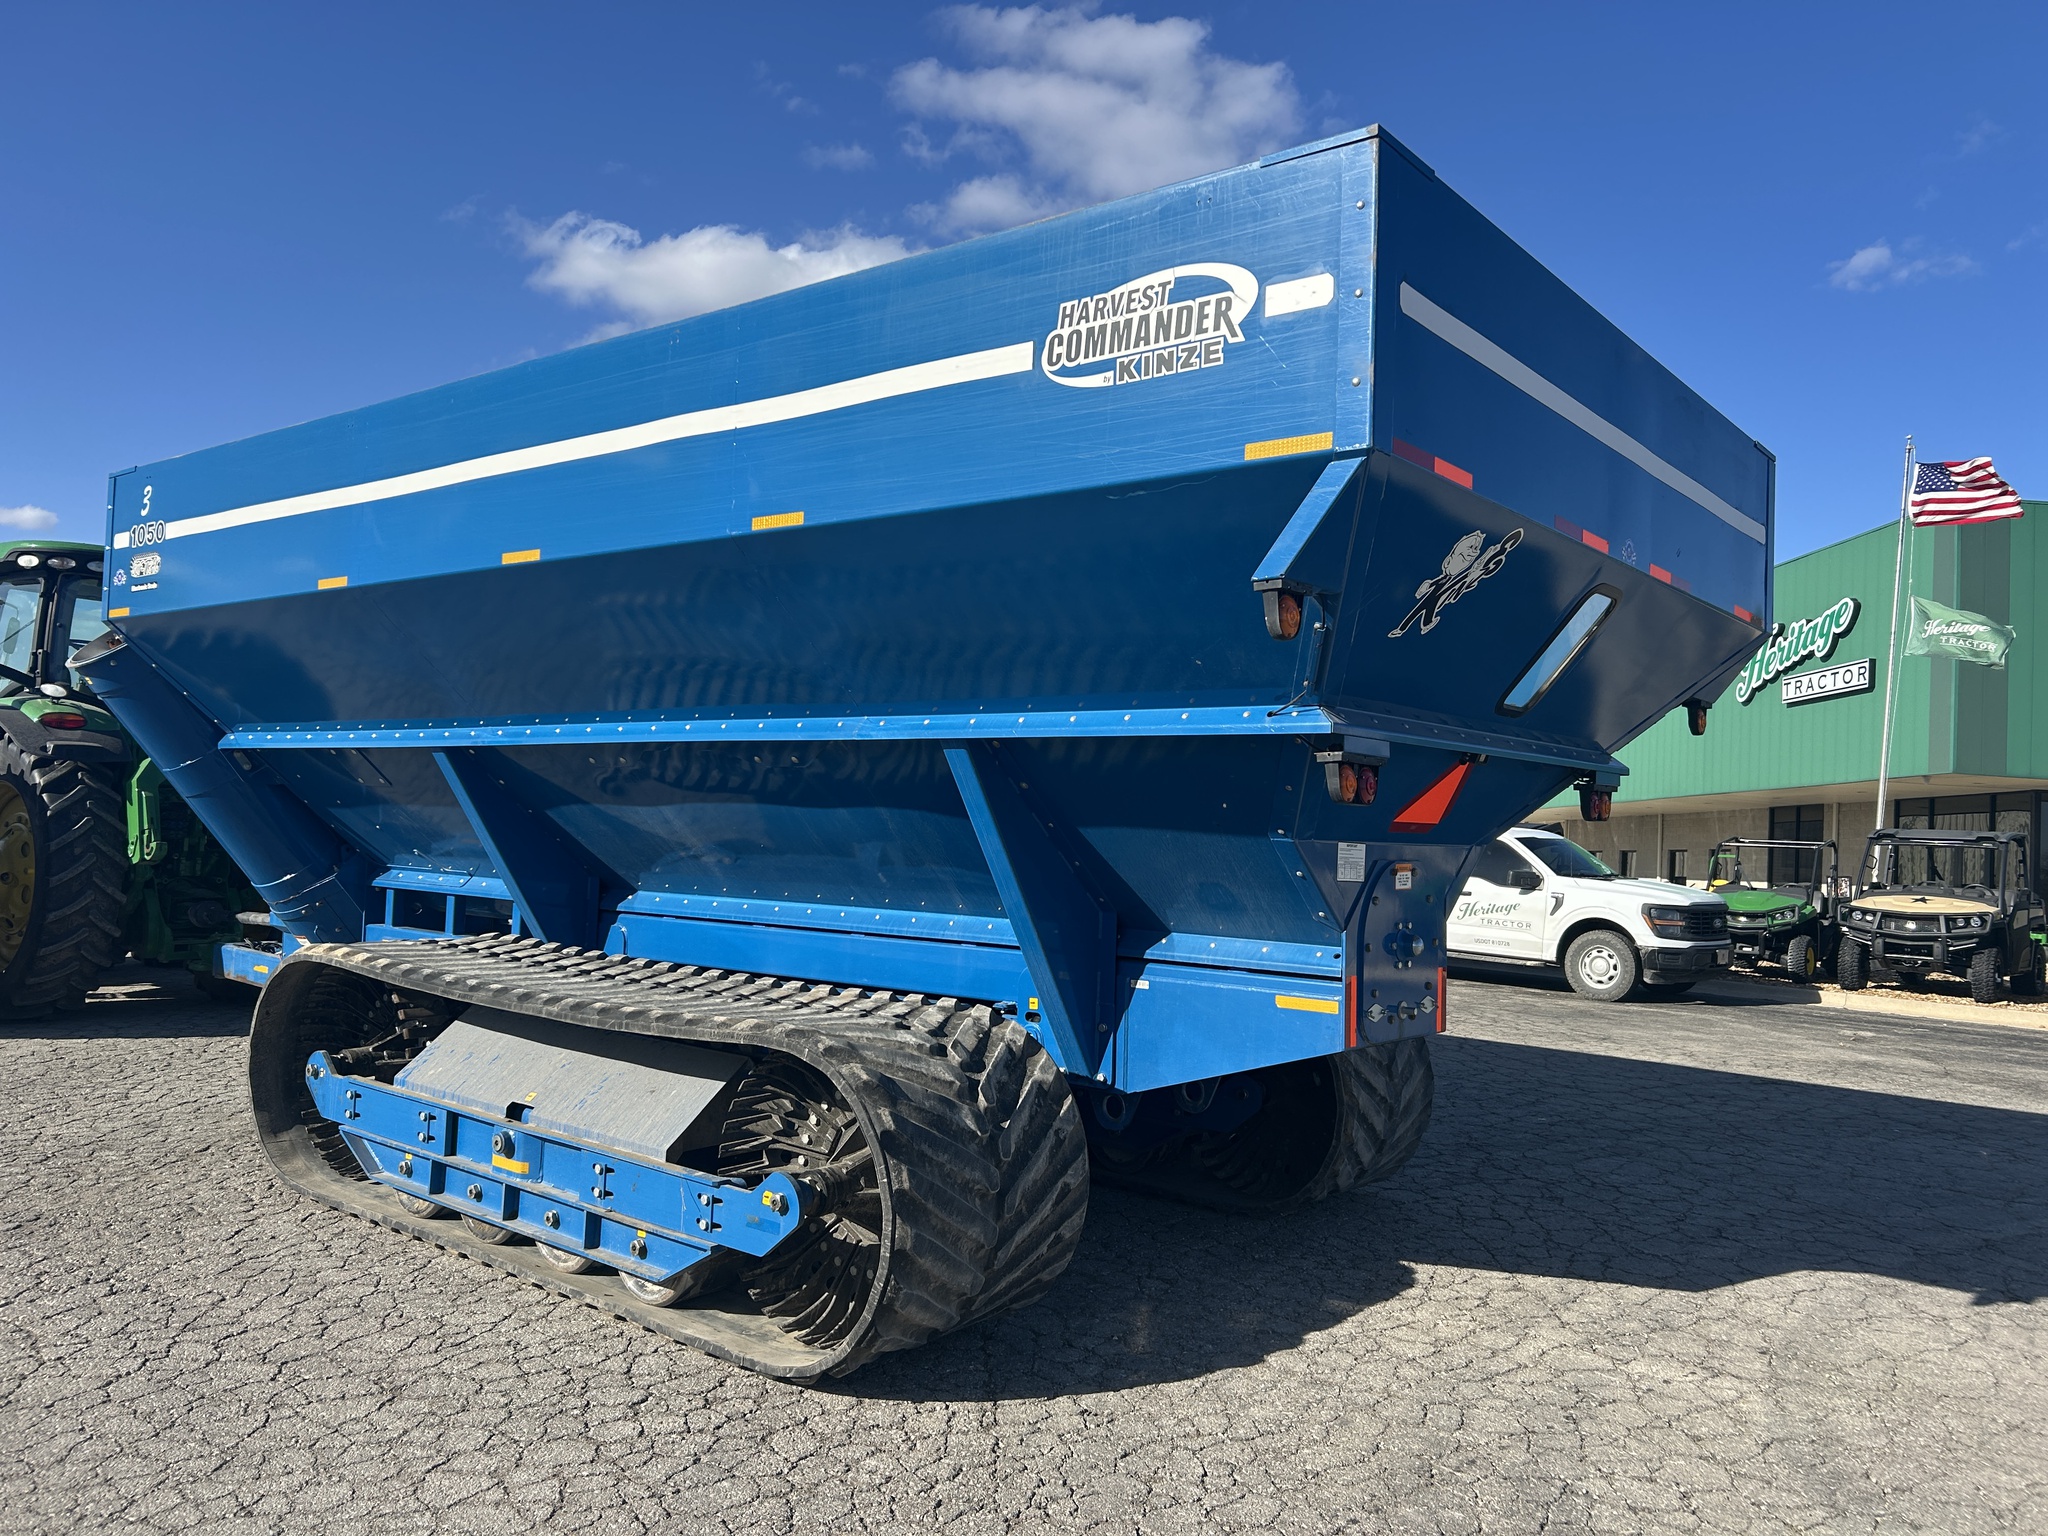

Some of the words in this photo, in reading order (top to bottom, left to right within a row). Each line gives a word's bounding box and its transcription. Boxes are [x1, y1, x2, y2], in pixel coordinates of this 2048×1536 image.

[1060, 280, 1172, 329] HARVEST
[1046, 296, 1239, 367] COMMANDER
[1103, 374, 1112, 385] by
[1116, 342, 1222, 382] KINZE
[140, 485, 152, 516] 3
[131, 520, 165, 548] 1050
[1922, 619, 1991, 638] Heritage
[1941, 636, 1997, 652] TRACTOR
[1736, 597, 1854, 702] Heritage
[1783, 665, 1868, 697] TRACTOR
[1457, 901, 1520, 920] Heritage
[1481, 918, 1532, 929] TRACTOR
